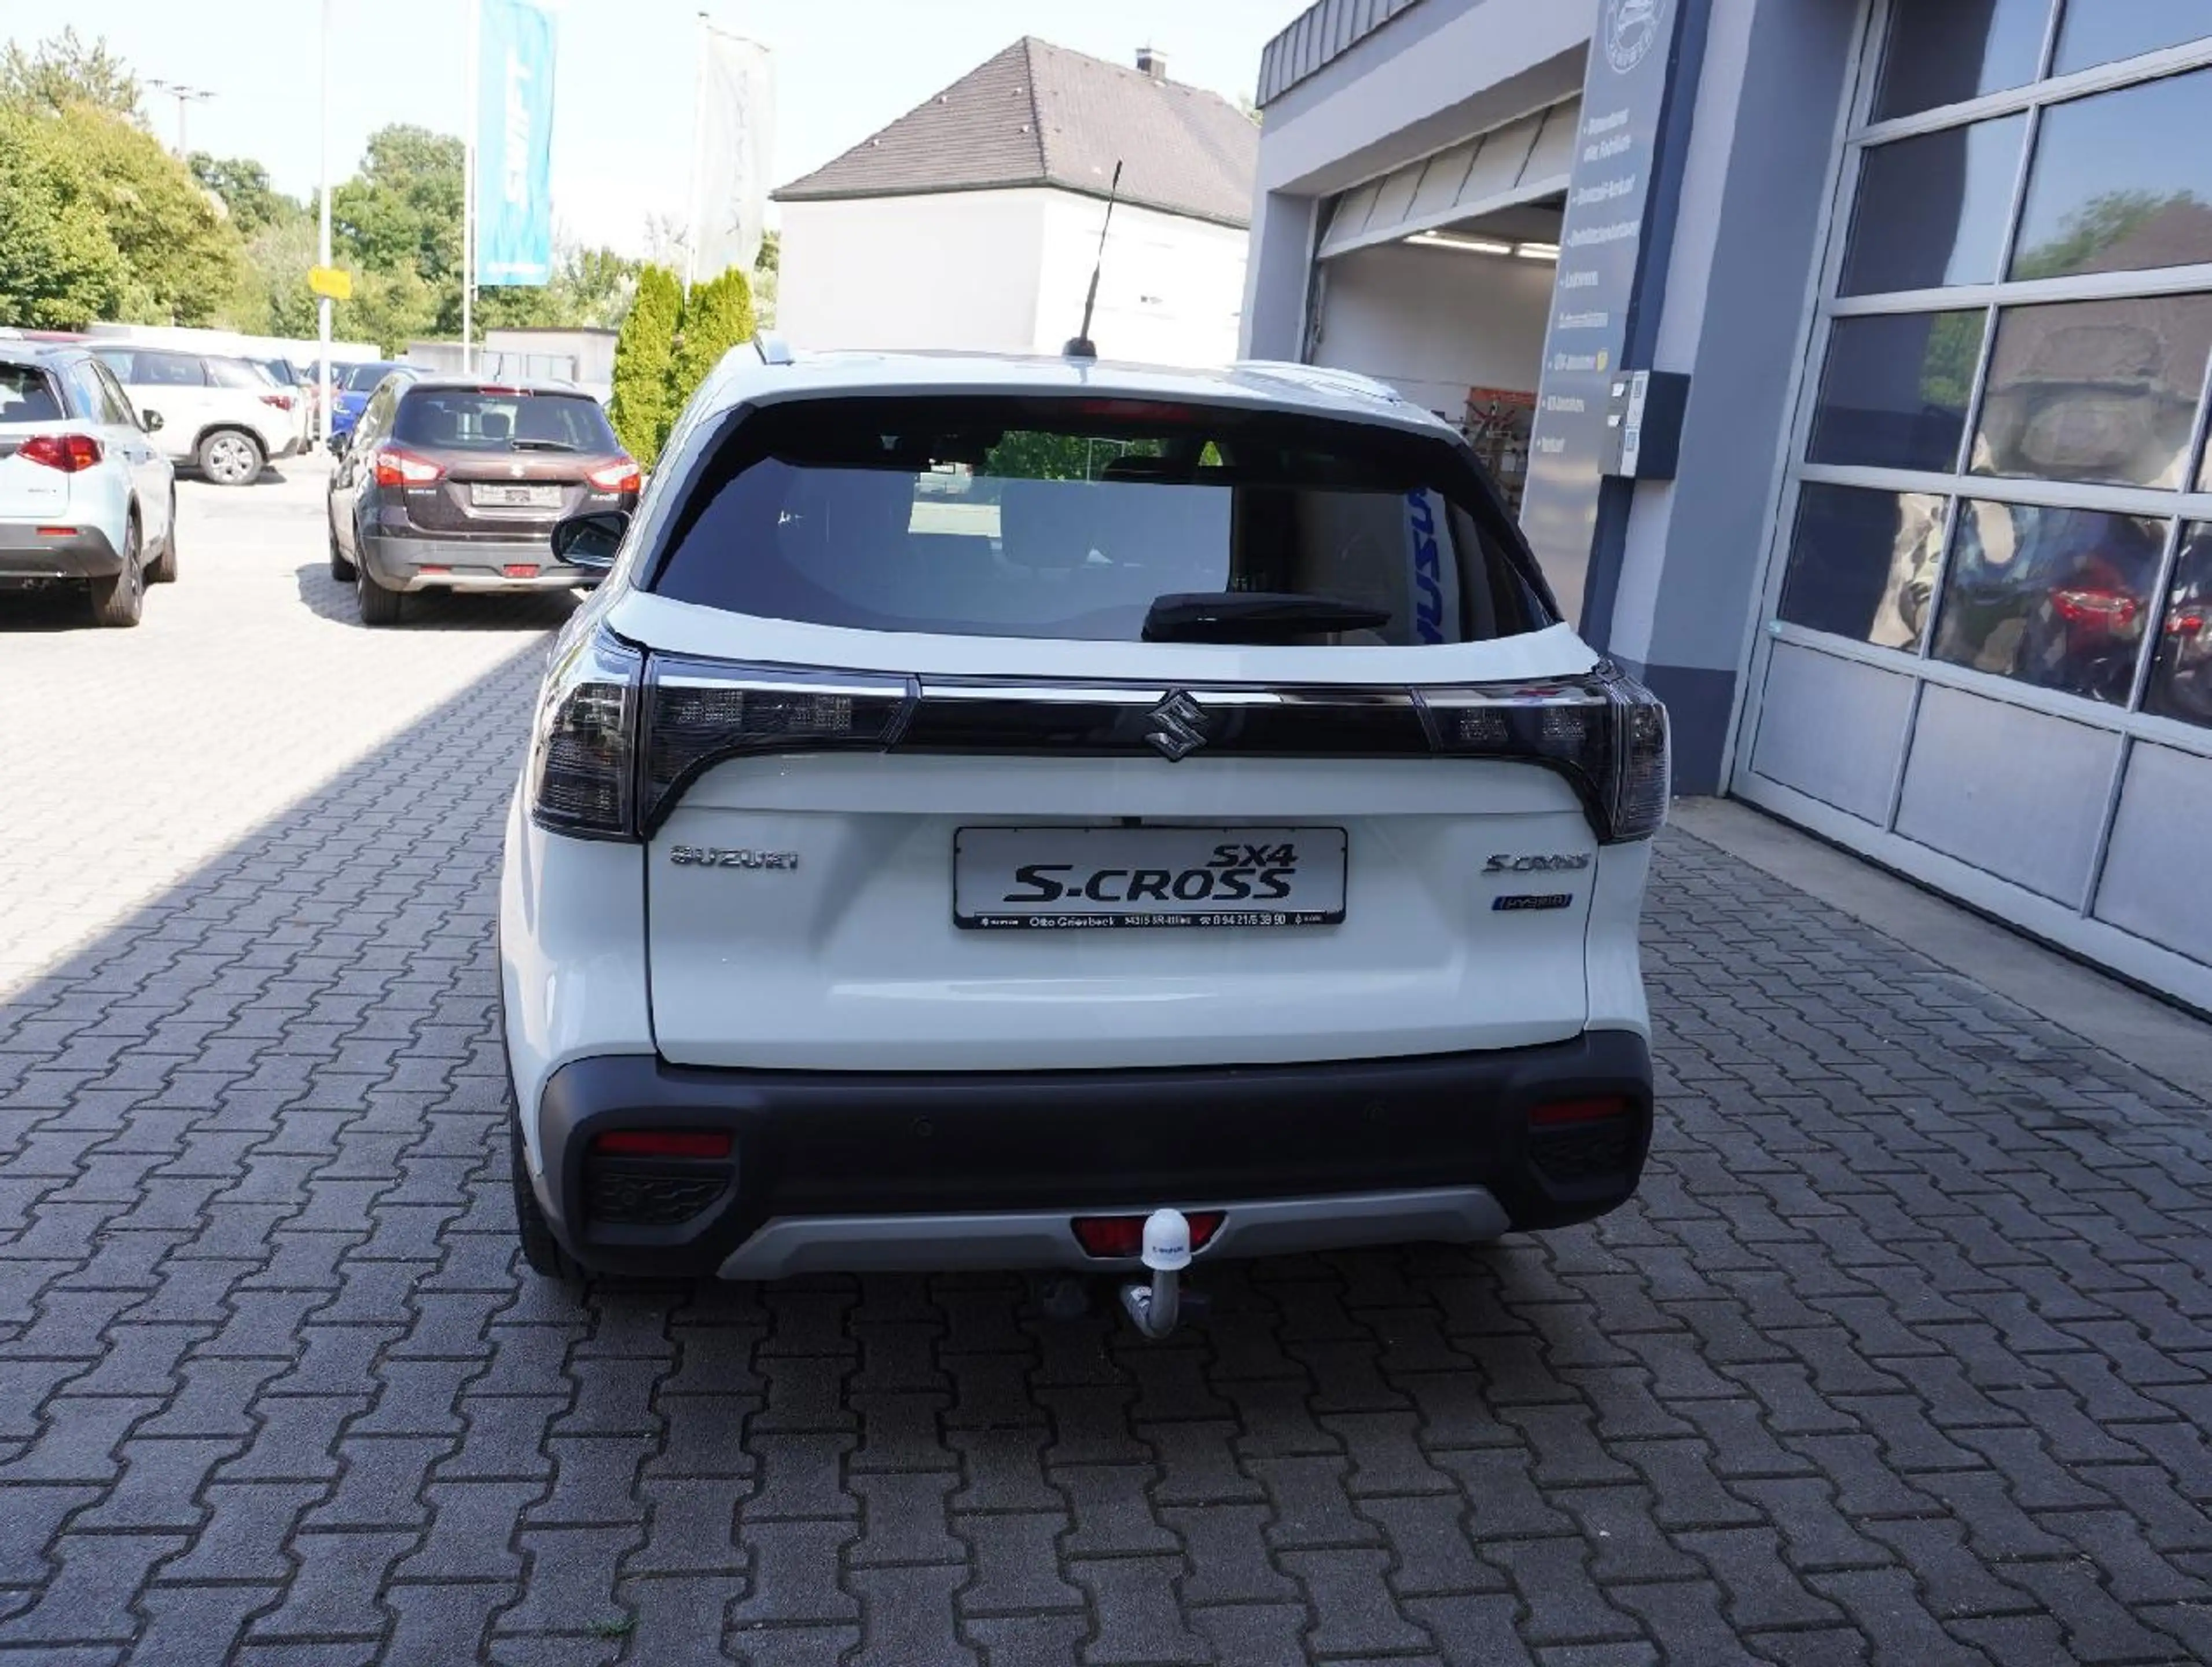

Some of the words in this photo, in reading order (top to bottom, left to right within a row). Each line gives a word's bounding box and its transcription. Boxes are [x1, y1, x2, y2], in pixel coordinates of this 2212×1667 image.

[504, 46, 533, 211] SWIFT
[670, 845, 798, 869] SUZUKI
[1206, 843, 1299, 867] SX4
[1003, 865, 1296, 902] S-CROSS
[1029, 917, 1055, 926] Otto
